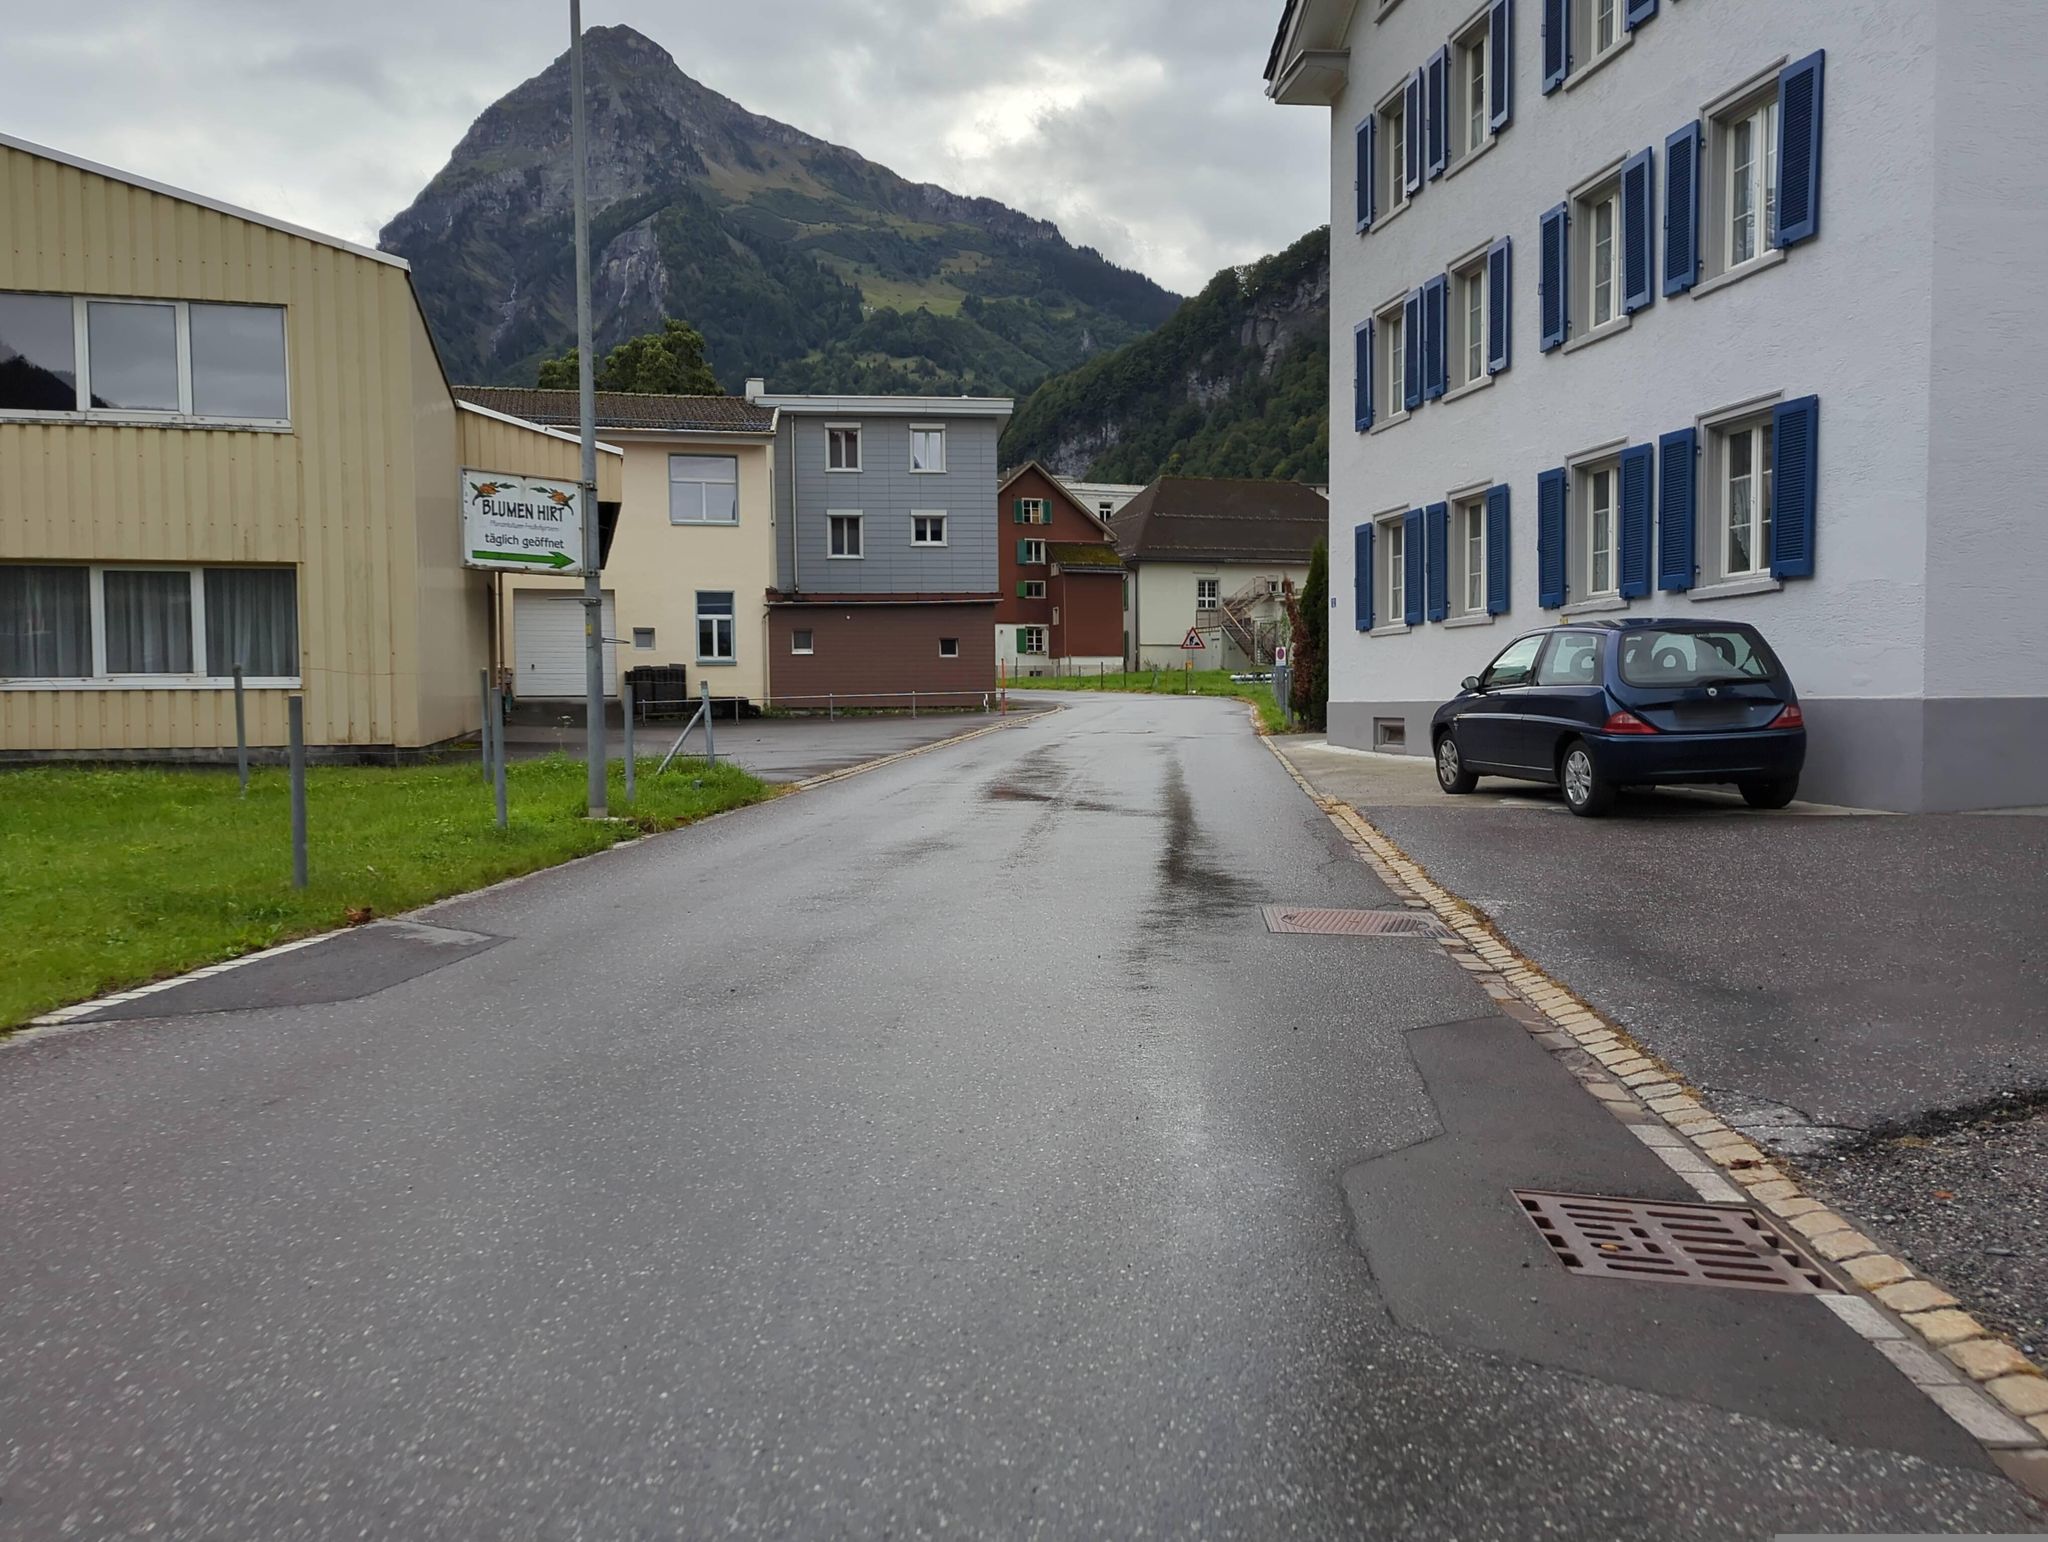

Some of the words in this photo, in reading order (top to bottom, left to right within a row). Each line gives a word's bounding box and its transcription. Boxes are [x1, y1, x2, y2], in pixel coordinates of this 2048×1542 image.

[482, 499, 534, 520] BLUMEN
[537, 505, 565, 522] HIRT
[485, 533, 519, 547] täglich
[522, 537, 564, 549] geöffnet
